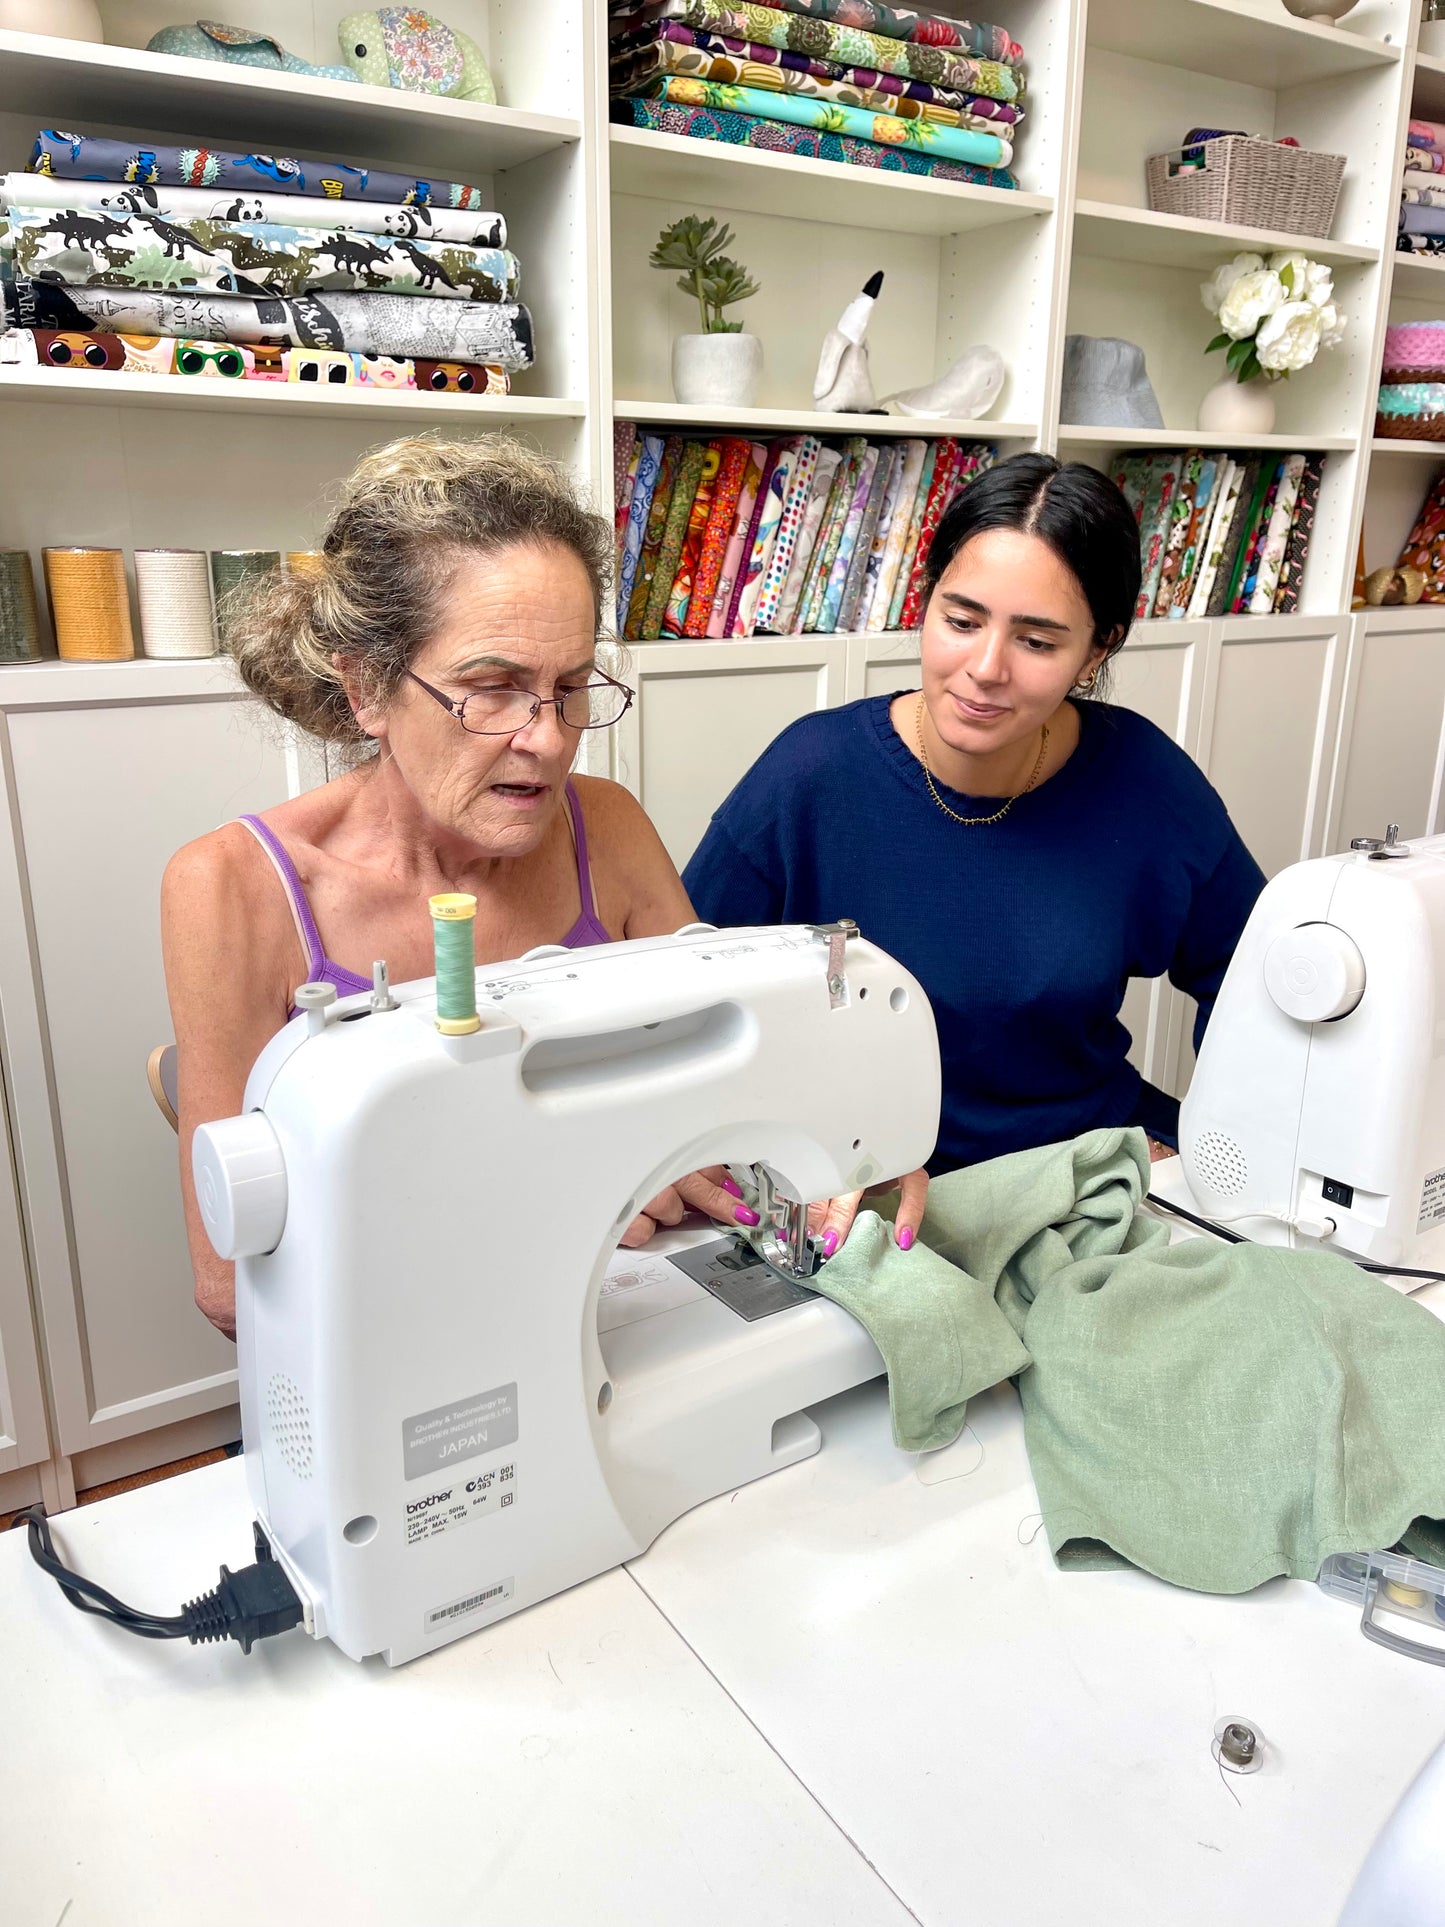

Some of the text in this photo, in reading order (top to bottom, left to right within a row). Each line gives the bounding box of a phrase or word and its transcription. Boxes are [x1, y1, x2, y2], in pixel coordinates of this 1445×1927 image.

[415, 1418, 443, 1433] Quality
[410, 1429, 449, 1448] BROTHER
[438, 1429, 488, 1458] JAPAN
[477, 1464, 514, 1484] ACN 001
[477, 1472, 514, 1491] 393 835
[406, 1490, 453, 1514] brother
[408, 1526, 428, 1538] LAMP
